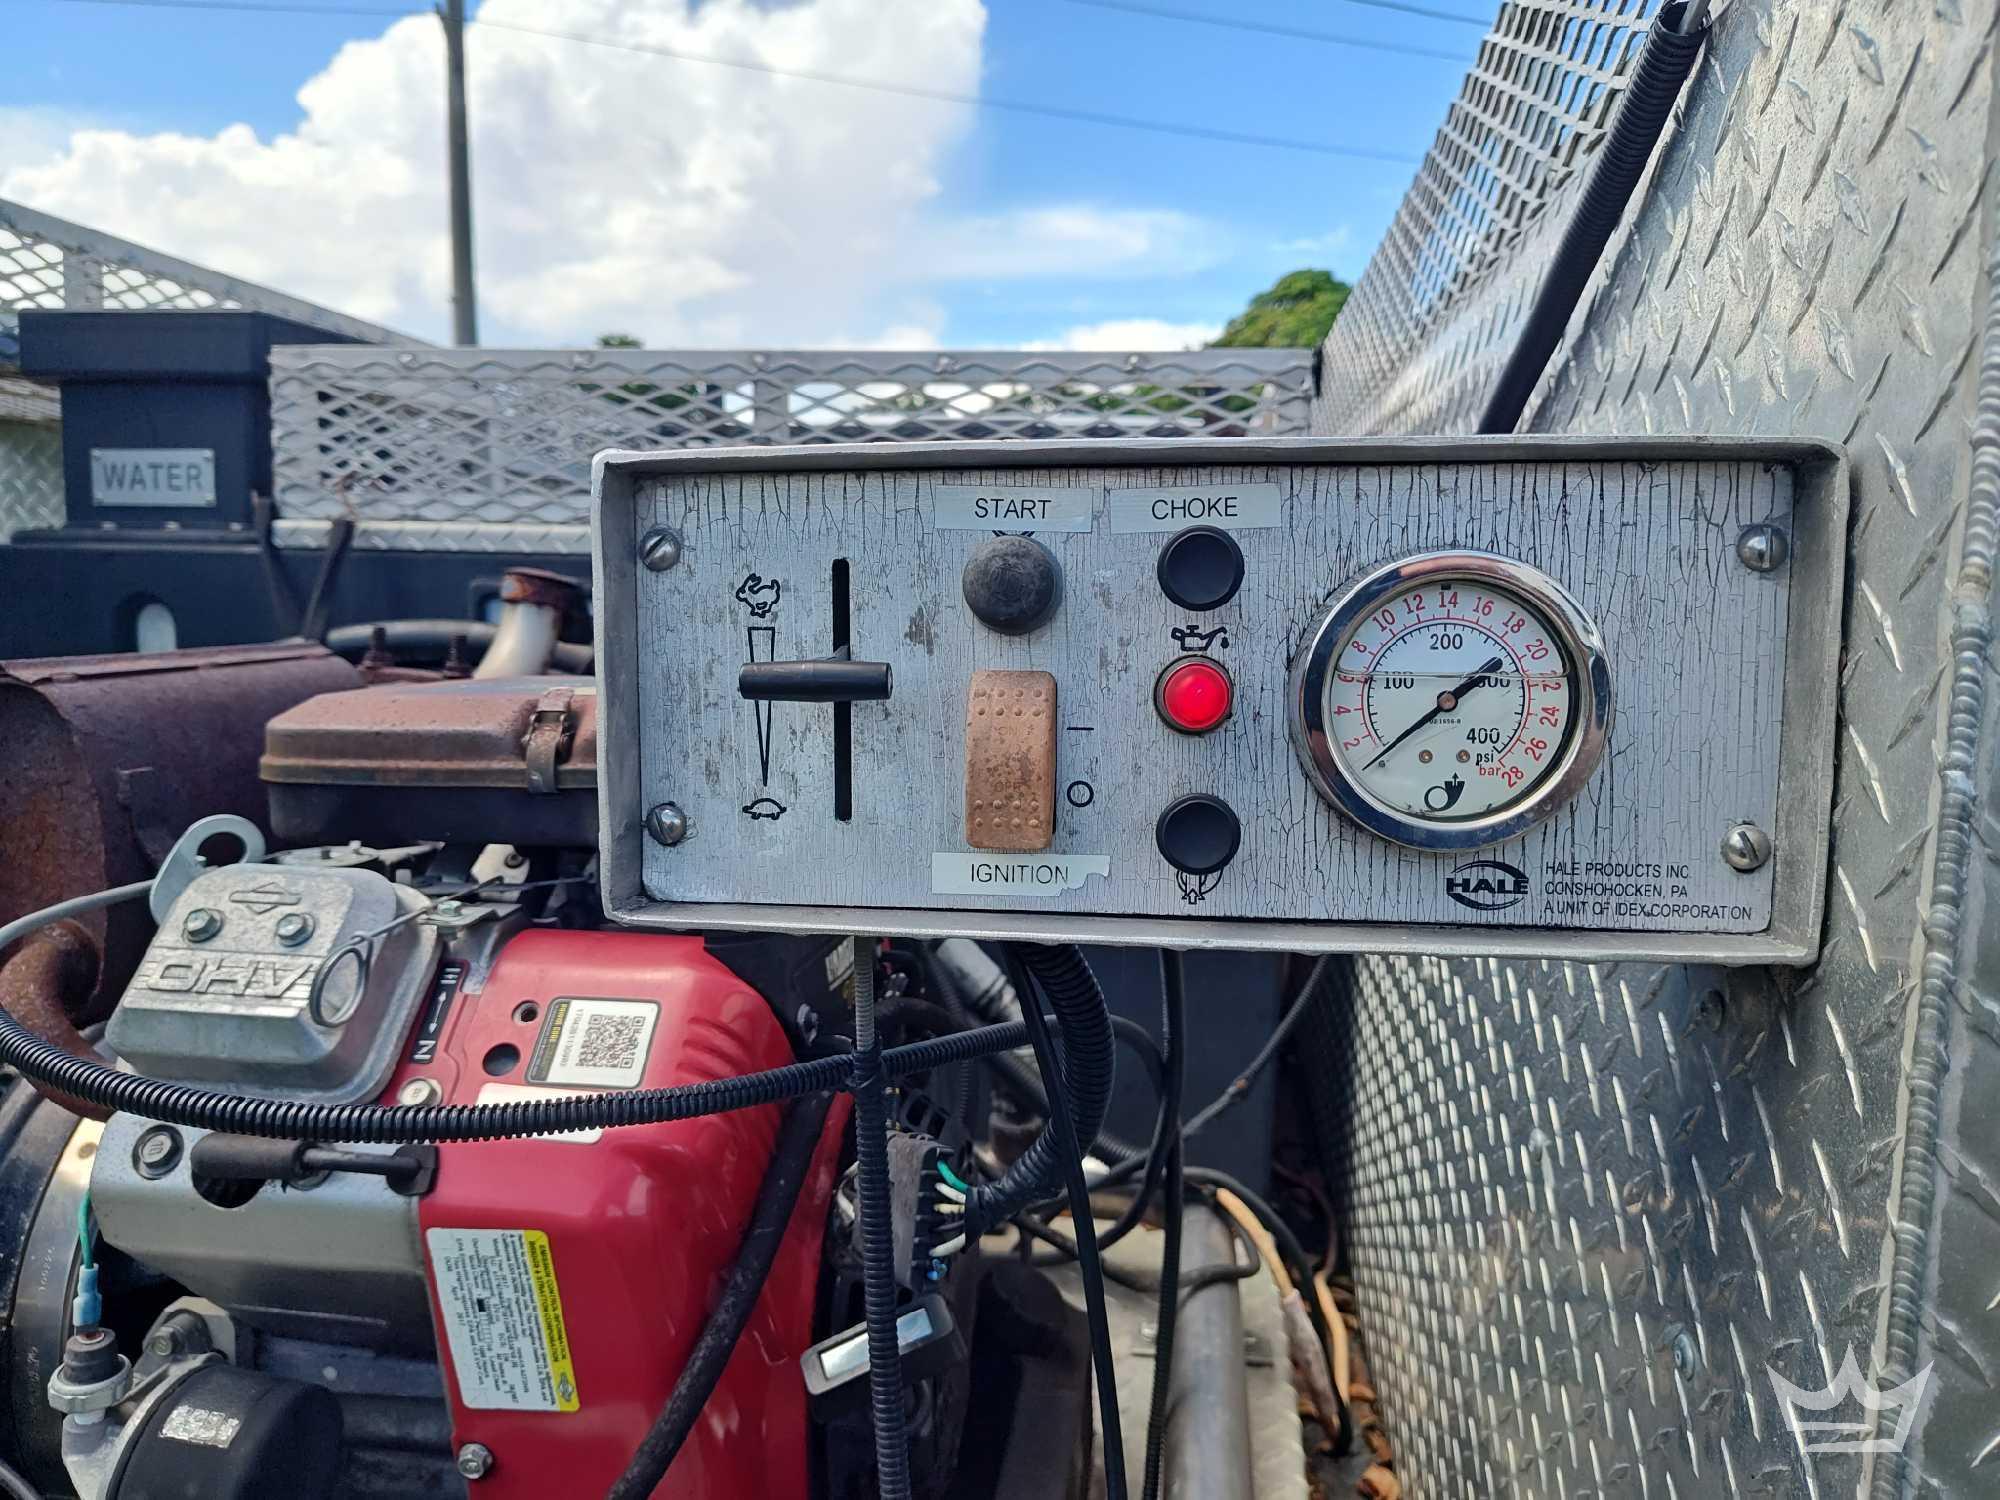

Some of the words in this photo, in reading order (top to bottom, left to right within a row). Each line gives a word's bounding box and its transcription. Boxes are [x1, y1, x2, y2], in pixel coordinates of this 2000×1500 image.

[102, 462, 203, 491] WATER
[975, 497, 1052, 519] START
[1151, 497, 1239, 520] CHOKE
[1402, 594, 1425, 614] 12
[1438, 591, 1458, 608] 14
[1472, 596, 1494, 616] 16
[1372, 608, 1395, 632] 10
[1502, 611, 1526, 634] 18
[1351, 640, 1367, 653] 8
[1430, 633, 1463, 650] 200
[1525, 638, 1549, 660] 20
[1383, 671, 1415, 690] 100
[1333, 705, 1352, 716] 4
[1539, 706, 1560, 728] 24
[1343, 738, 1361, 751] 2
[1466, 727, 1500, 744] 400
[1476, 750, 1494, 766] psi
[1524, 737, 1548, 761] 26
[1479, 764, 1501, 776] bar
[1501, 766, 1524, 788] 28
[970, 863, 1069, 885] IGNITION
[1545, 862, 1580, 876] HALE
[1585, 862, 1662, 878] PRODUCTS
[1446, 877, 1530, 895] HALE
[1671, 885, 1688, 898] PA
[1544, 900, 1554, 914] A
[1556, 901, 1588, 914] UNIT
[1592, 901, 1610, 915] OF
[1615, 902, 1647, 917] IDEX
[147, 957, 315, 999] OHV
